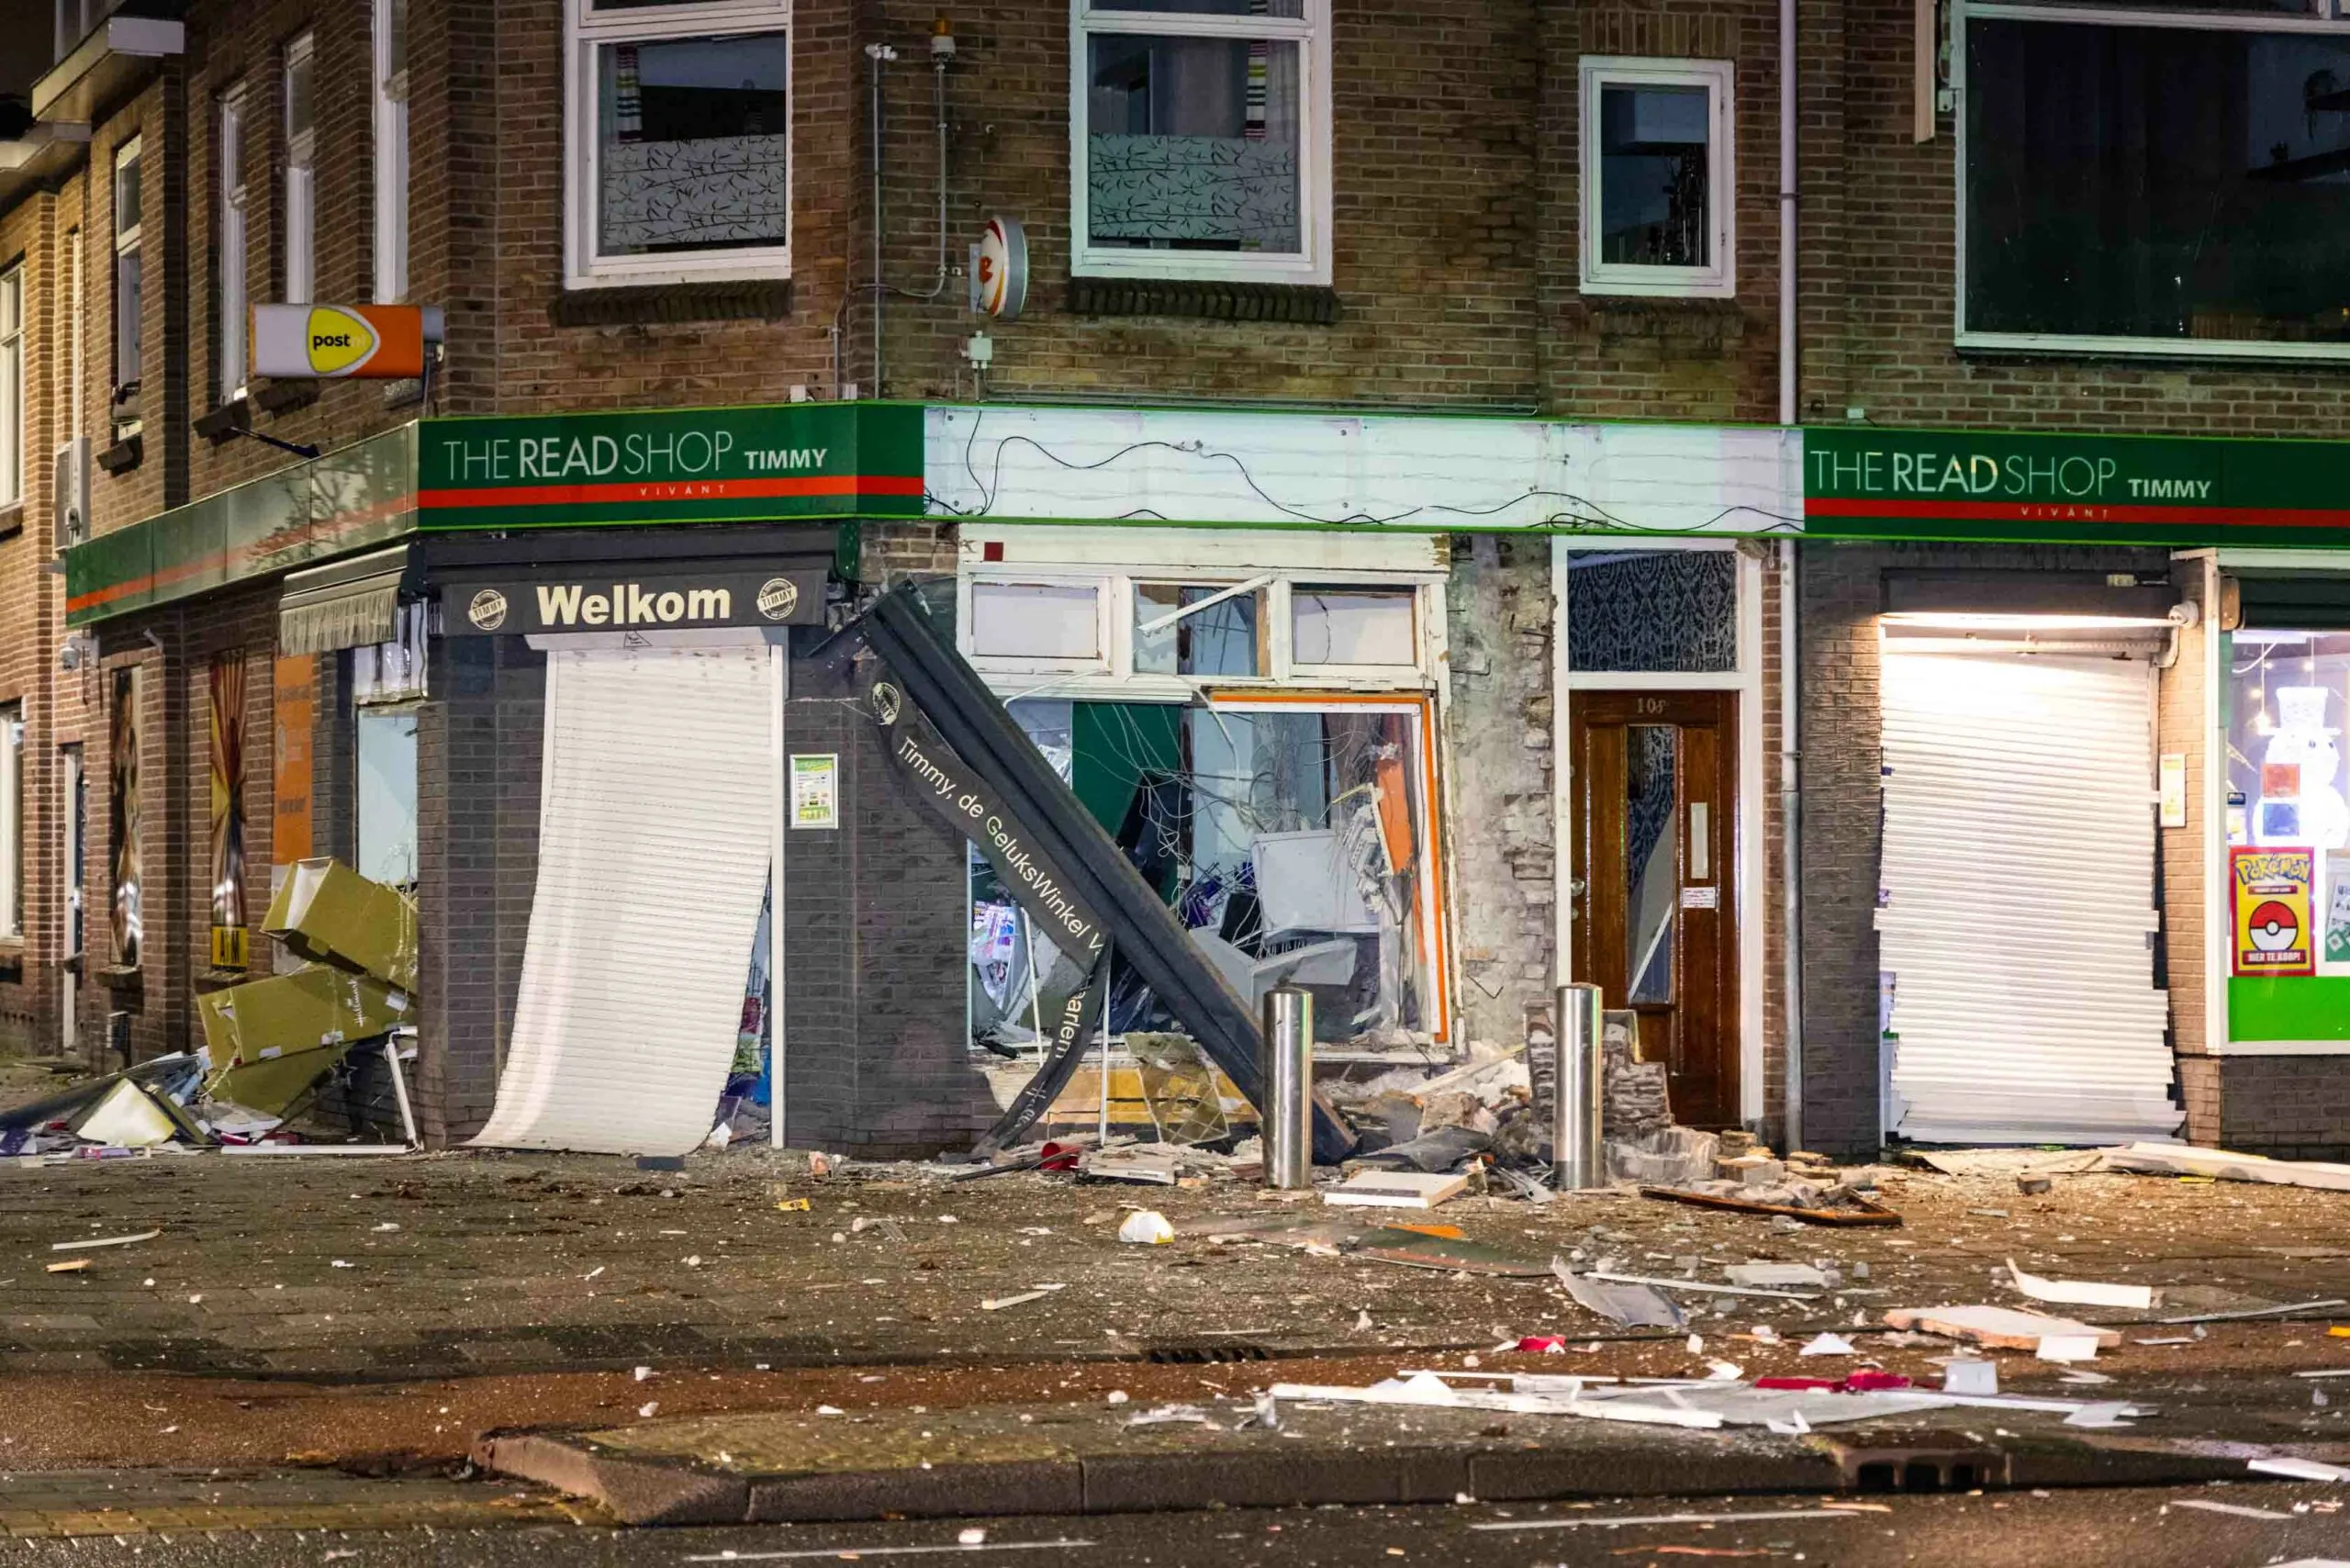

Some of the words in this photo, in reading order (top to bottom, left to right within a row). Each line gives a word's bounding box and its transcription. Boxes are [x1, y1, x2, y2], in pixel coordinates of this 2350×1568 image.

[442, 440, 510, 480] THE
[520, 435, 619, 477] READ
[624, 431, 733, 475] SHOP
[744, 448, 828, 470] TIMMY
[1809, 451, 1884, 489] THE
[1893, 453, 1998, 493] READ
[2005, 455, 2116, 496] SHOP
[2128, 478, 2211, 498] TIMMY
[640, 484, 725, 496] VIVANT
[2021, 507, 2108, 519] VIVANT
[474, 599, 502, 619] TIMMY
[536, 584, 731, 625] Welkom
[761, 588, 793, 608] TIMMY
[898, 736, 957, 800] Timmy,
[958, 793, 984, 818] de
[986, 816, 1091, 938] GeluksWinkel
